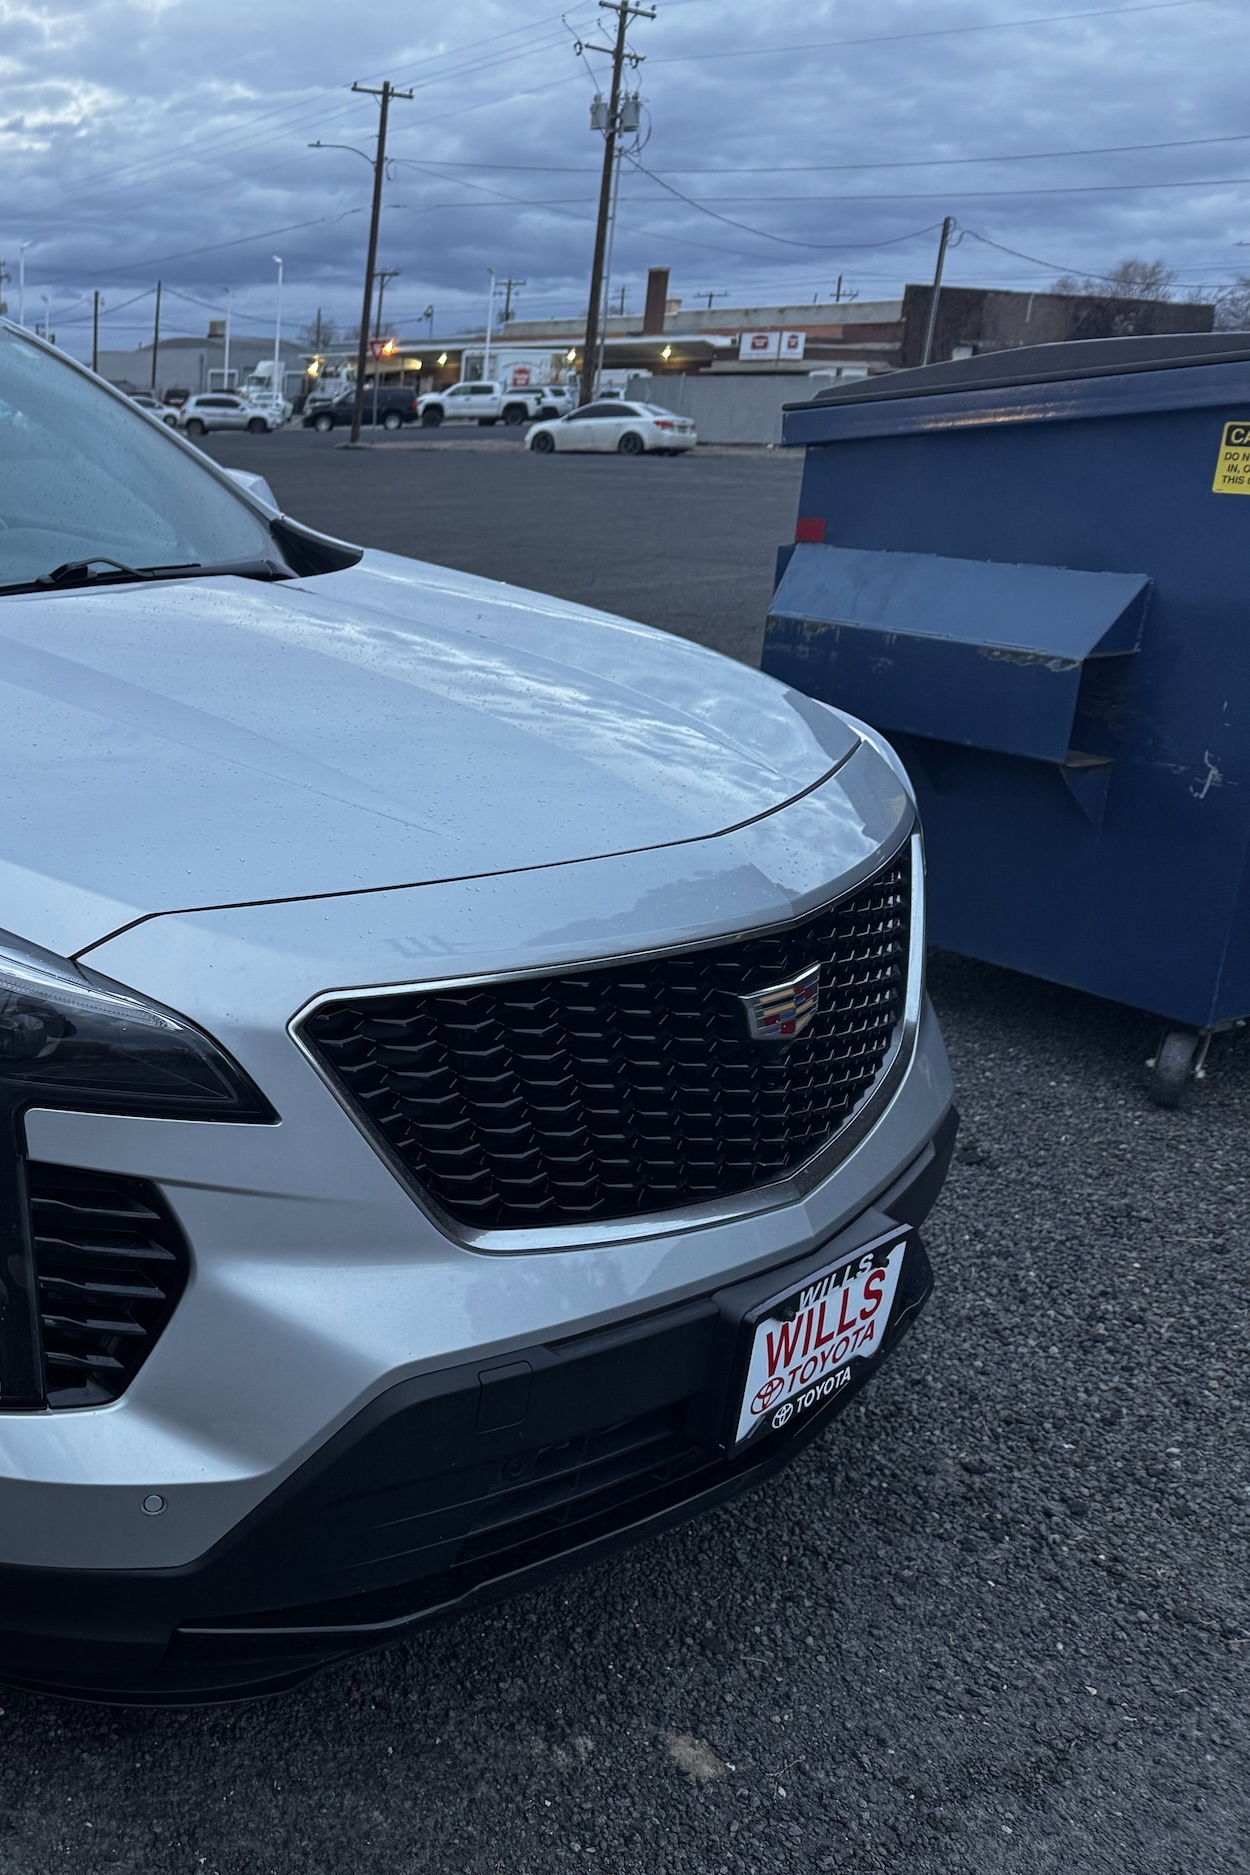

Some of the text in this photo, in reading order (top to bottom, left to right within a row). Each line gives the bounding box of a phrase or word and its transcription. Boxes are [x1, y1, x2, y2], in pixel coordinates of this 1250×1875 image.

[1222, 475, 1245, 485] THIS
[1224, 452, 1240, 461] DO
[1227, 464, 1240, 474] IN,
[800, 1252, 874, 1308] WILLS
[766, 1269, 886, 1378] WILLS
[787, 1319, 875, 1393] TOYOTA
[796, 1366, 851, 1413] TOYOTA
